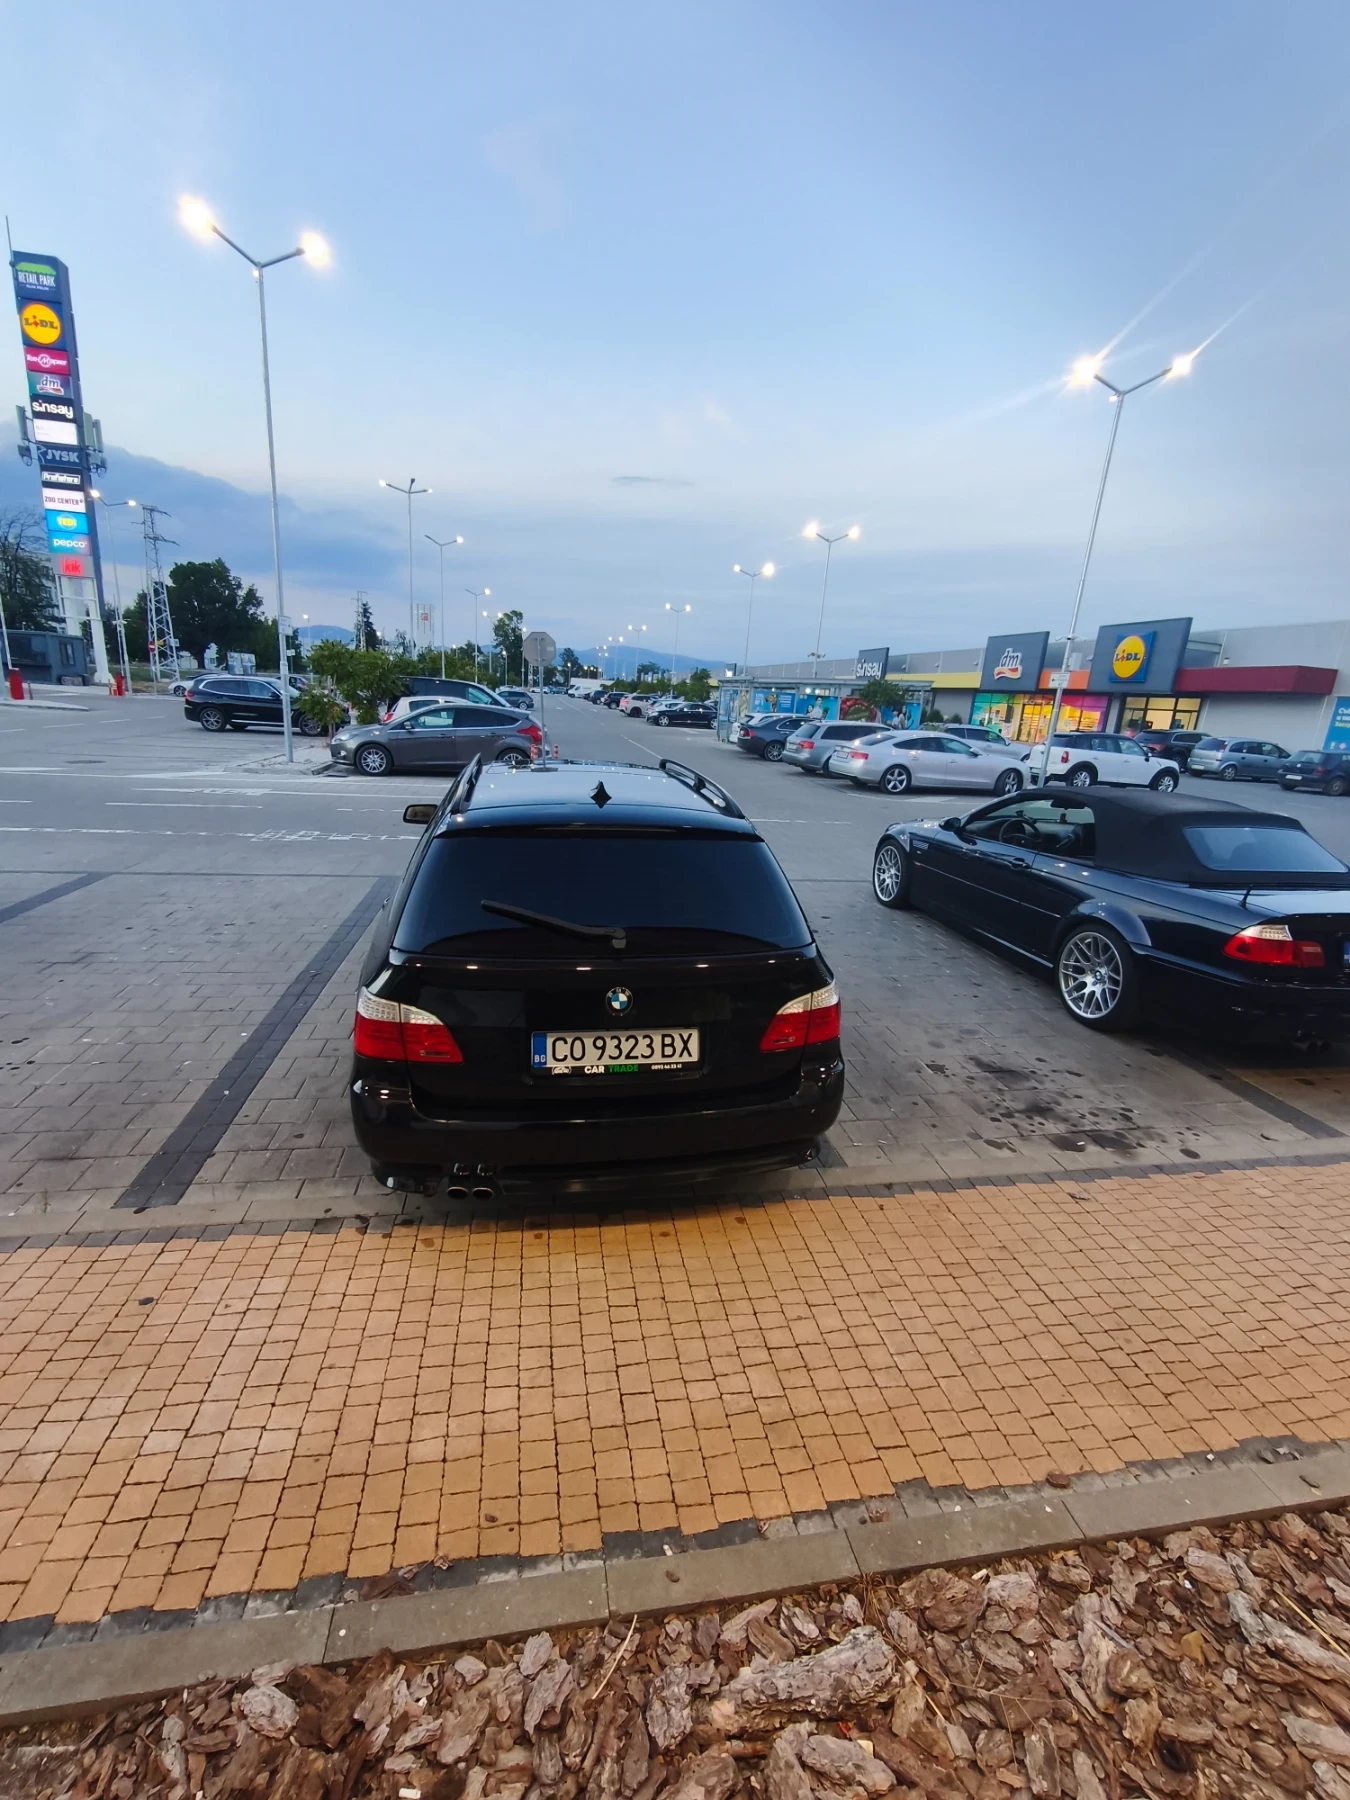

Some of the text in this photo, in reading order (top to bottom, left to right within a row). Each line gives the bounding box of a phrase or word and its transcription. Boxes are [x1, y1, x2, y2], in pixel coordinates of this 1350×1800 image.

[18, 271, 56, 287] RETAIL PARK
[41, 375, 60, 388] dm
[32, 400, 73, 419] sinsay
[46, 449, 79, 463] JYSK
[57, 498, 80, 506] CENTER
[53, 538, 85, 548] pepco
[1000, 648, 1019, 668] dm
[856, 658, 883, 680] sinsay
[551, 1033, 693, 1063] CO 9323 BX
[534, 1055, 546, 1063] BG
[584, 1065, 605, 1074] CAR
[608, 1064, 639, 1073] TRADE
